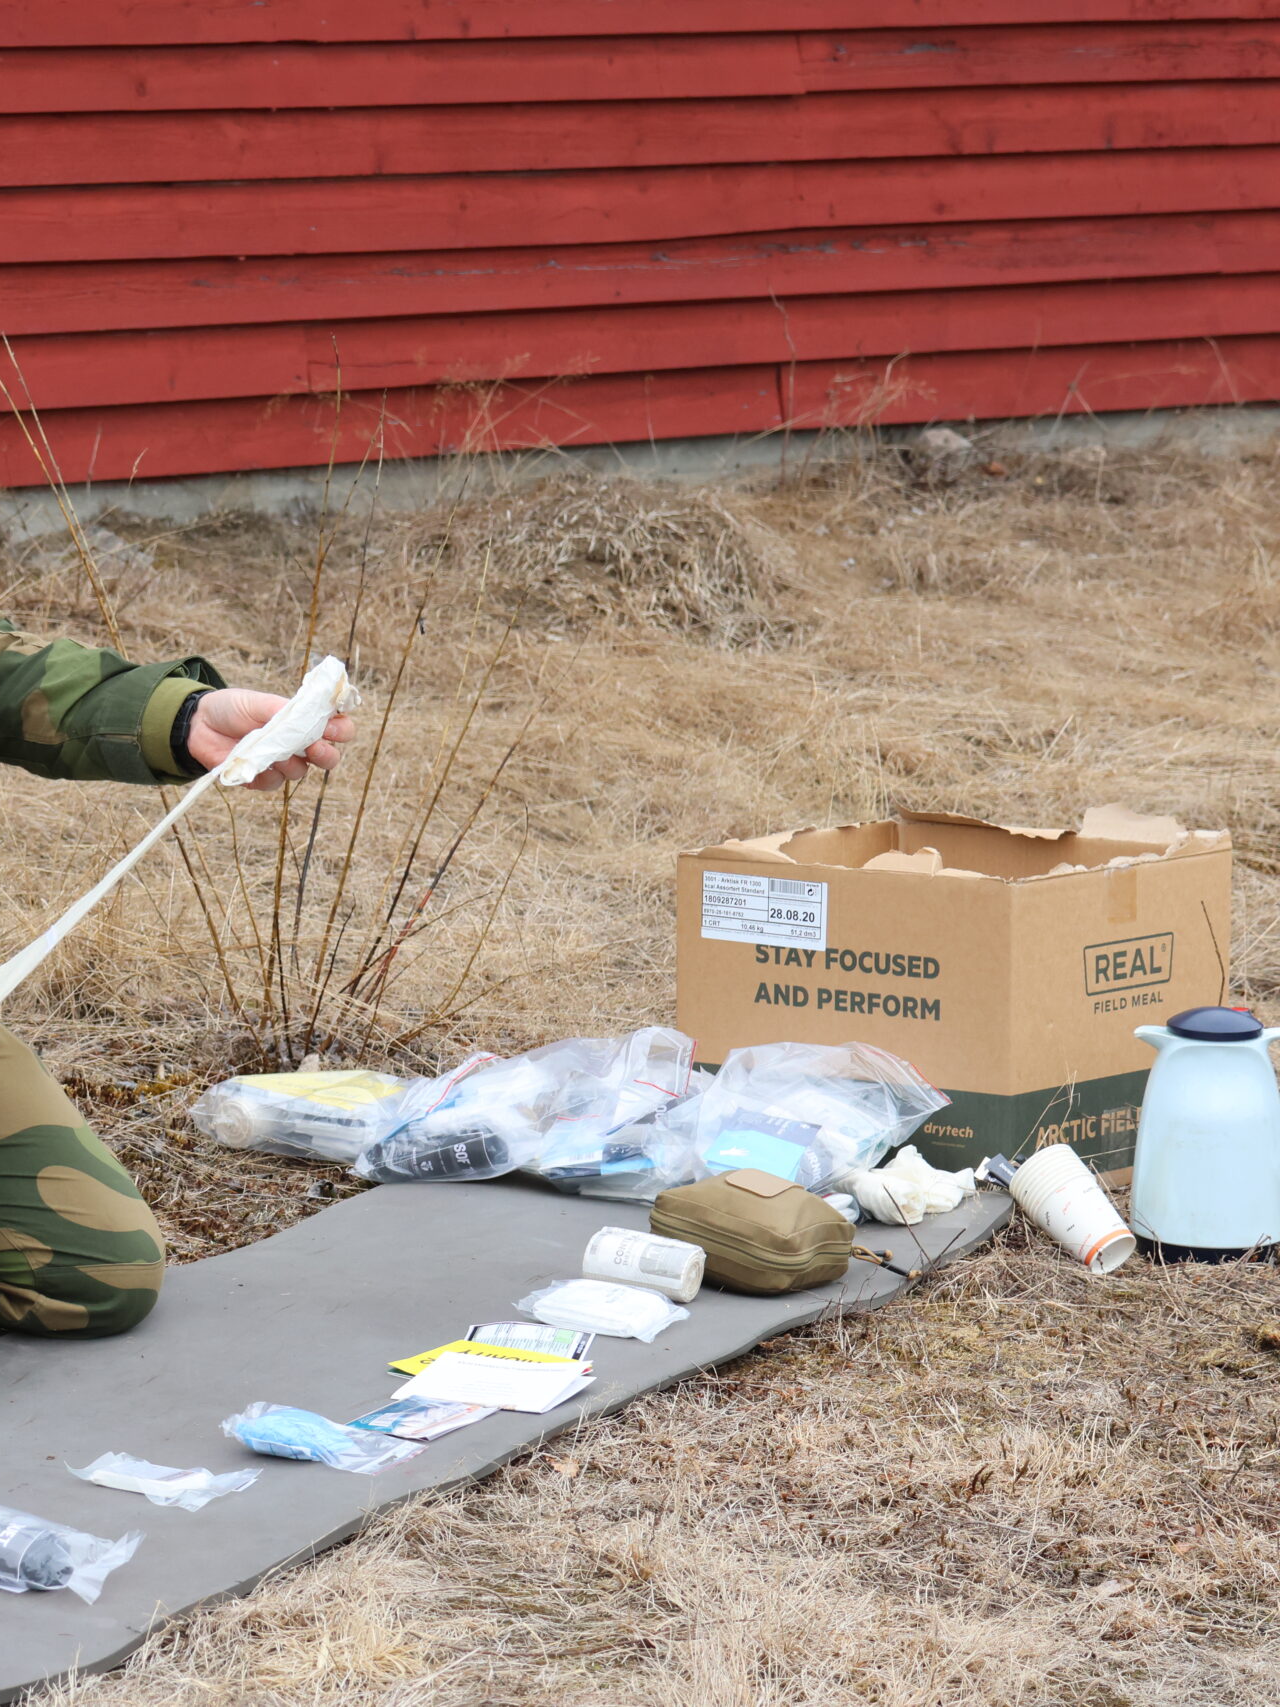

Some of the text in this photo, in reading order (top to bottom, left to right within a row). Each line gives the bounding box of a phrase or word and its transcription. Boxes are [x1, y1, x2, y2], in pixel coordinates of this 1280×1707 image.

[704, 895, 747, 907] 1809287201
[770, 908, 816, 923] 28.08.20
[756, 925, 764, 933] kg
[755, 943, 940, 979] STAY FOCUSED
[754, 982, 941, 1021] AND PERFORM
[1094, 991, 1164, 1014] FIELD MEAL
[923, 1121, 975, 1139] drytech
[1035, 1116, 1097, 1150] ARCTIC
